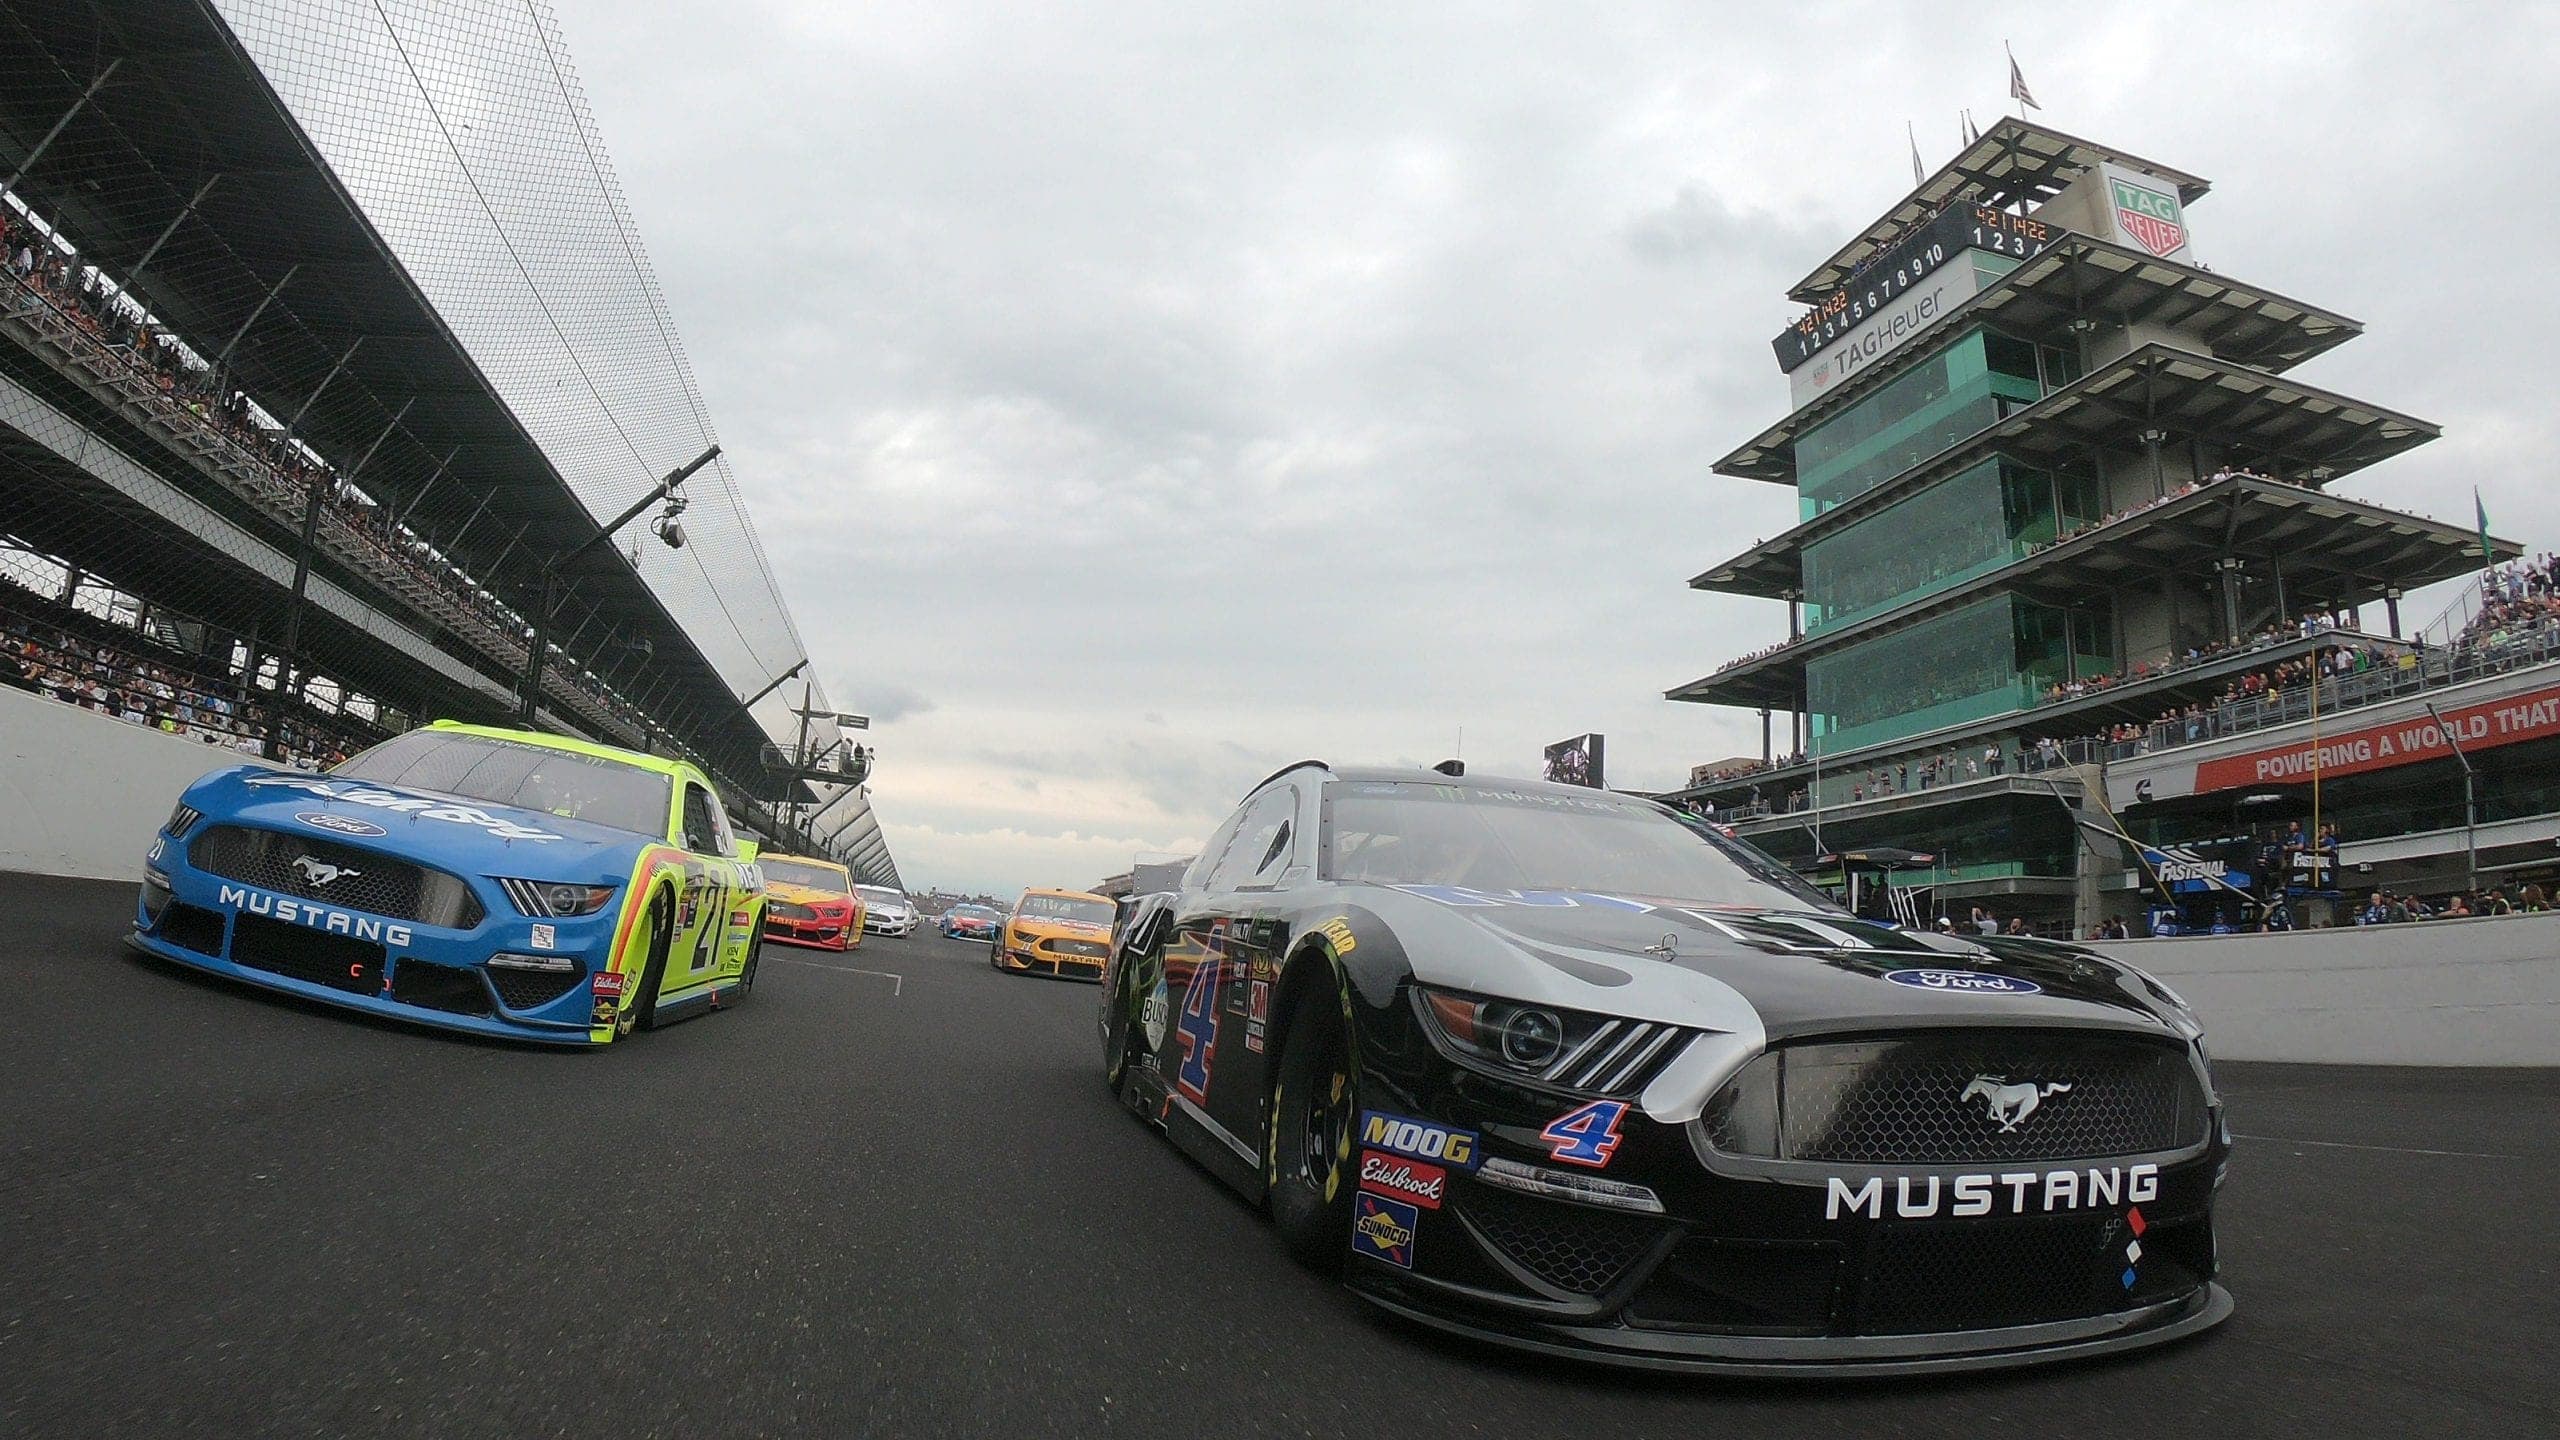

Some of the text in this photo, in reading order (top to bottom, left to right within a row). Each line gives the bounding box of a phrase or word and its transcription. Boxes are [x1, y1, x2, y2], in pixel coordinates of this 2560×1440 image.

[2117, 184, 2176, 220] TAG
[1973, 227, 1982, 245] 1
[1994, 232, 2004, 250] 2
[2014, 237, 2024, 254] 3
[2121, 209, 2181, 255] HEUER
[1800, 243, 1943, 356] 1 2 3 4 5 6 7 8 9 10
[2256, 698, 2560, 780] POWERING A WORLD THAT
[310, 814, 369, 834] Ford
[148, 838, 166, 861] 21
[218, 885, 412, 947] MUSTANG
[690, 869, 729, 972] 21
[1917, 970, 2015, 993] Ford
[1175, 917, 1230, 1107] 4
[1362, 1115, 1473, 1165] MOOG
[1539, 1099, 1633, 1169] 4
[1361, 1156, 1443, 1201] Edelbrock
[1826, 1164, 2158, 1221] MUSTANG
[1360, 1217, 1409, 1244] SUNOCO
